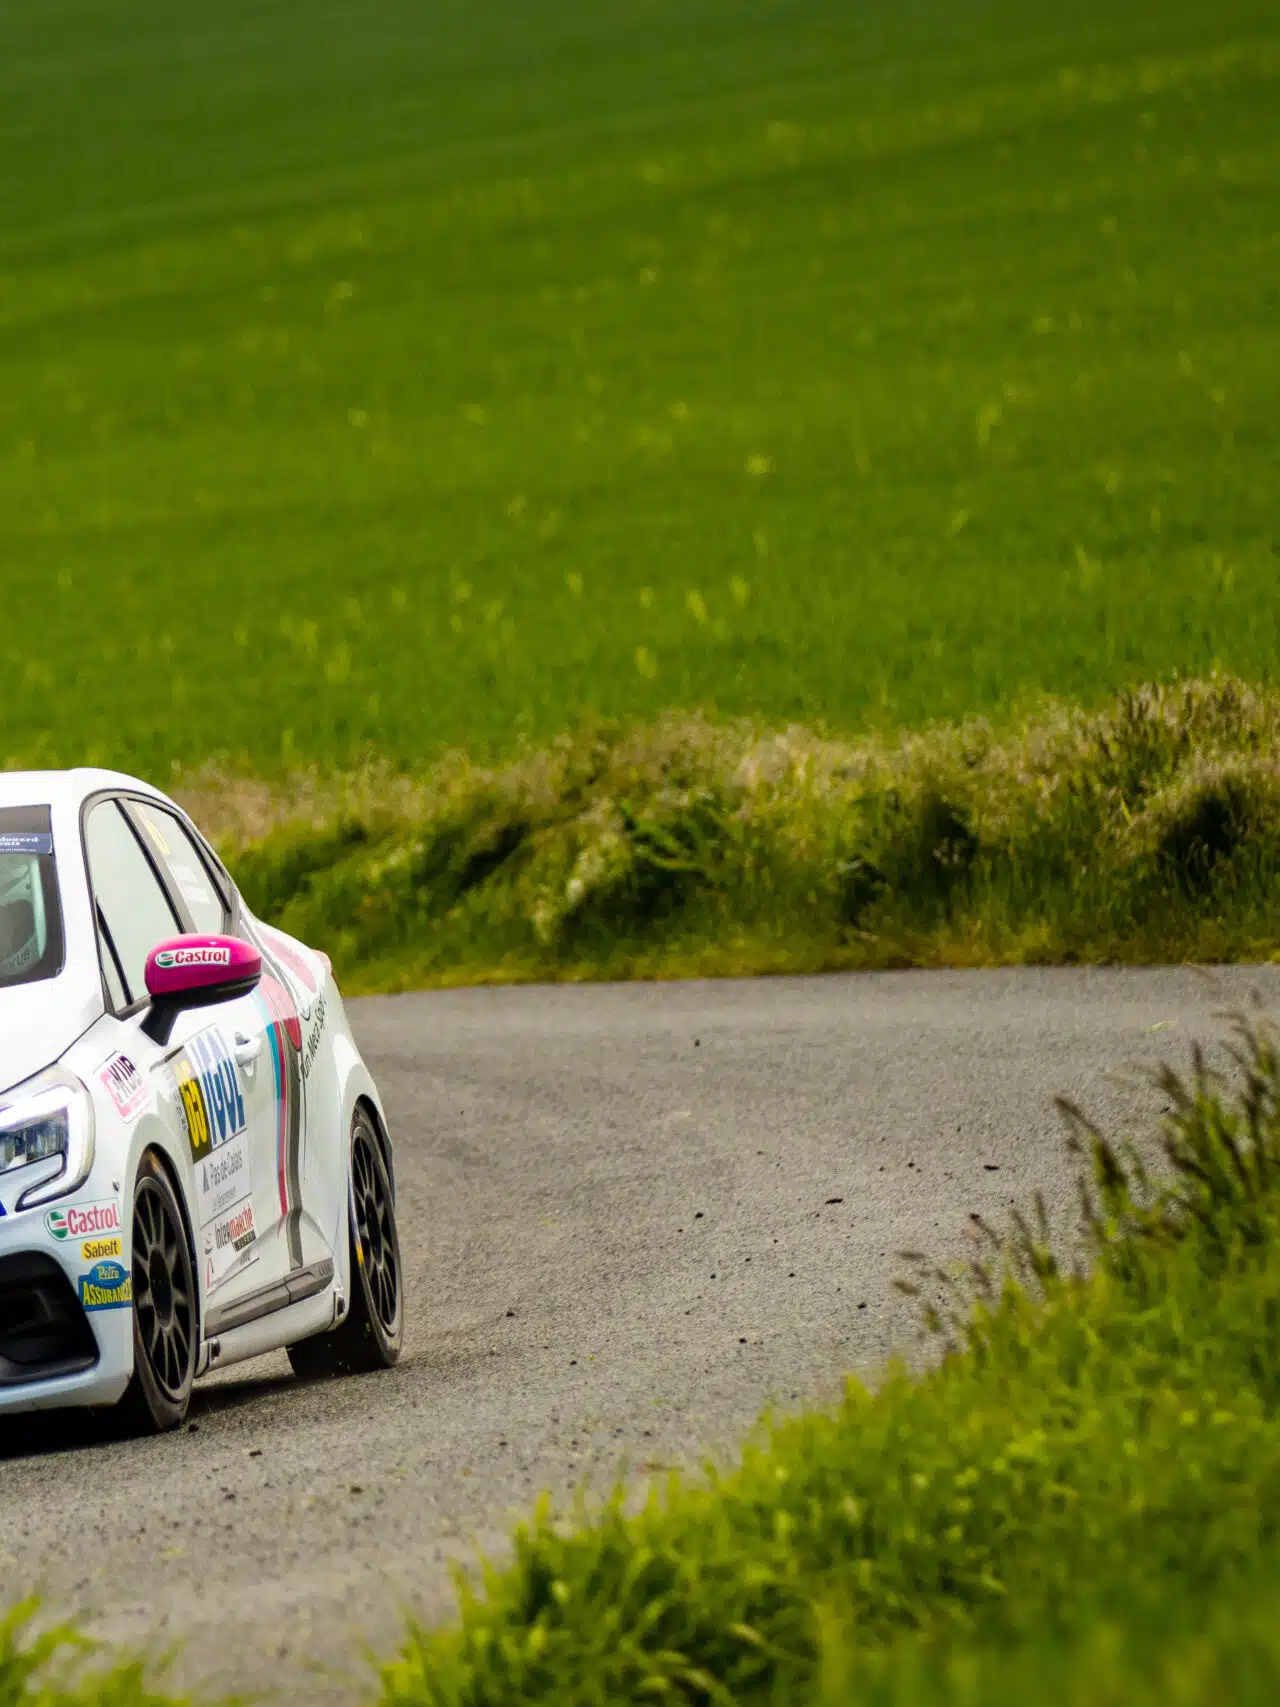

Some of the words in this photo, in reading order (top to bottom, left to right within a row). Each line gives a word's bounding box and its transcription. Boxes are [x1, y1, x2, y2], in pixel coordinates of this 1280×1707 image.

[175, 949, 227, 965] Castrol
[67, 1203, 120, 1235] Castrol
[84, 1240, 118, 1259] Sabelt
[82, 1277, 132, 1306] ASSURANCES
